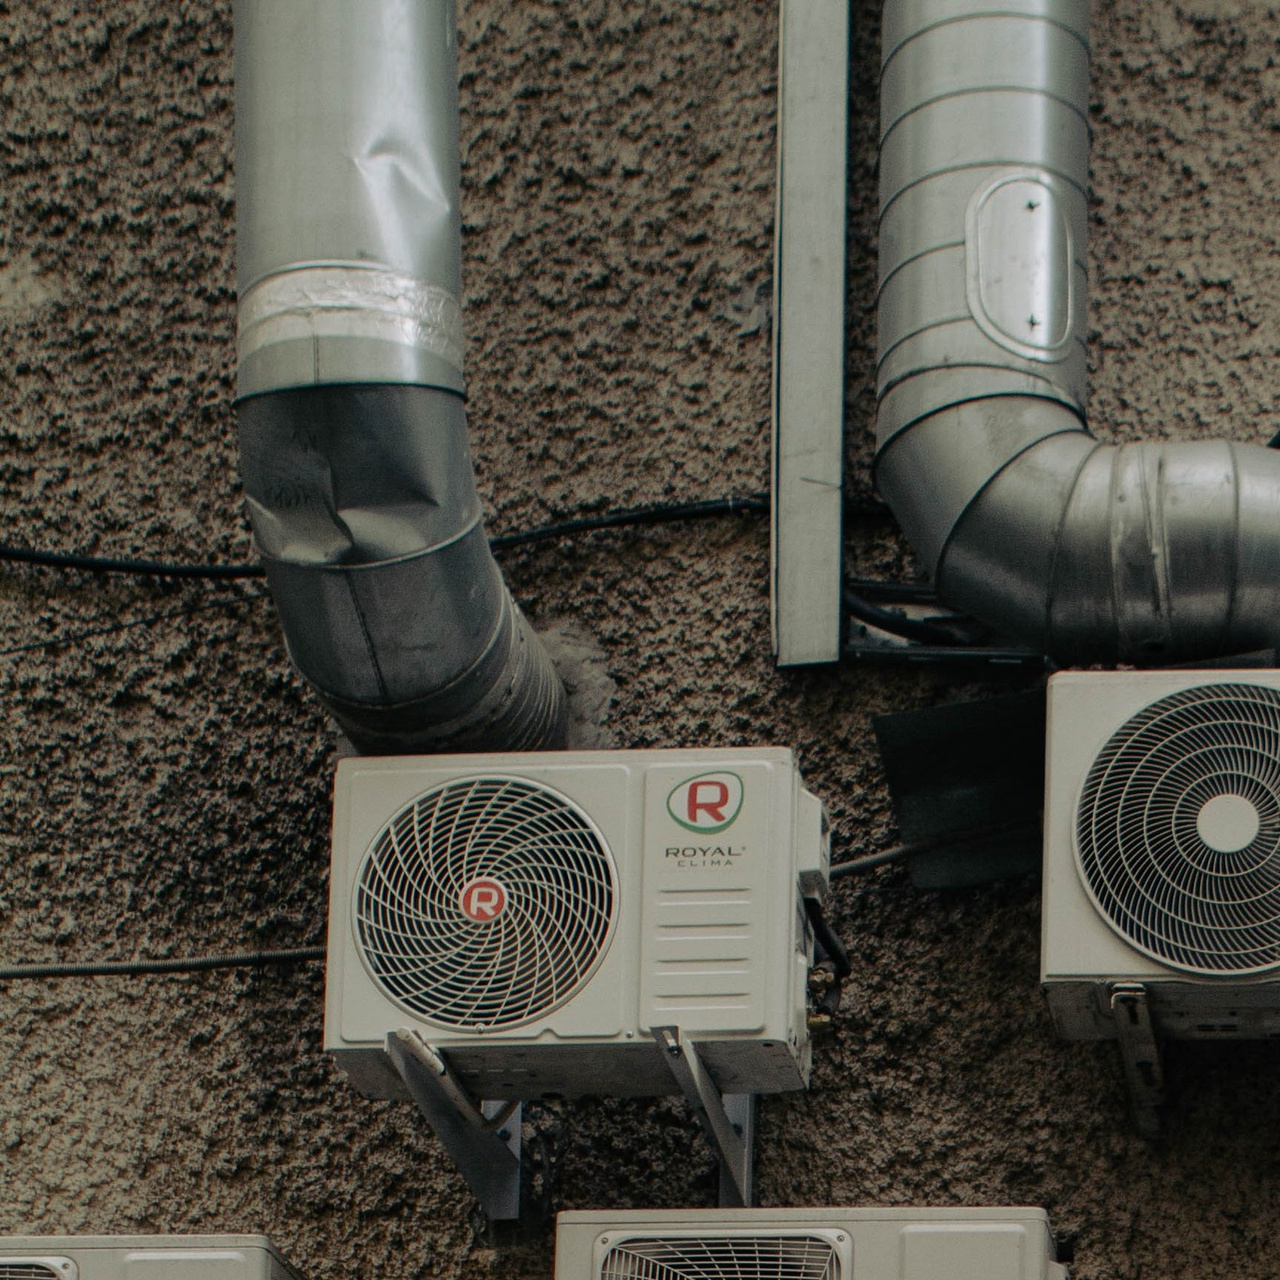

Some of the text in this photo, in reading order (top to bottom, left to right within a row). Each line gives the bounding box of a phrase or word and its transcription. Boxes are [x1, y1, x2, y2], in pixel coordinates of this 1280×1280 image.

[688, 780, 729, 823] R
[664, 846, 743, 859] ROYAL
[677, 859, 733, 868] CLIMA
[470, 886, 499, 916] R
